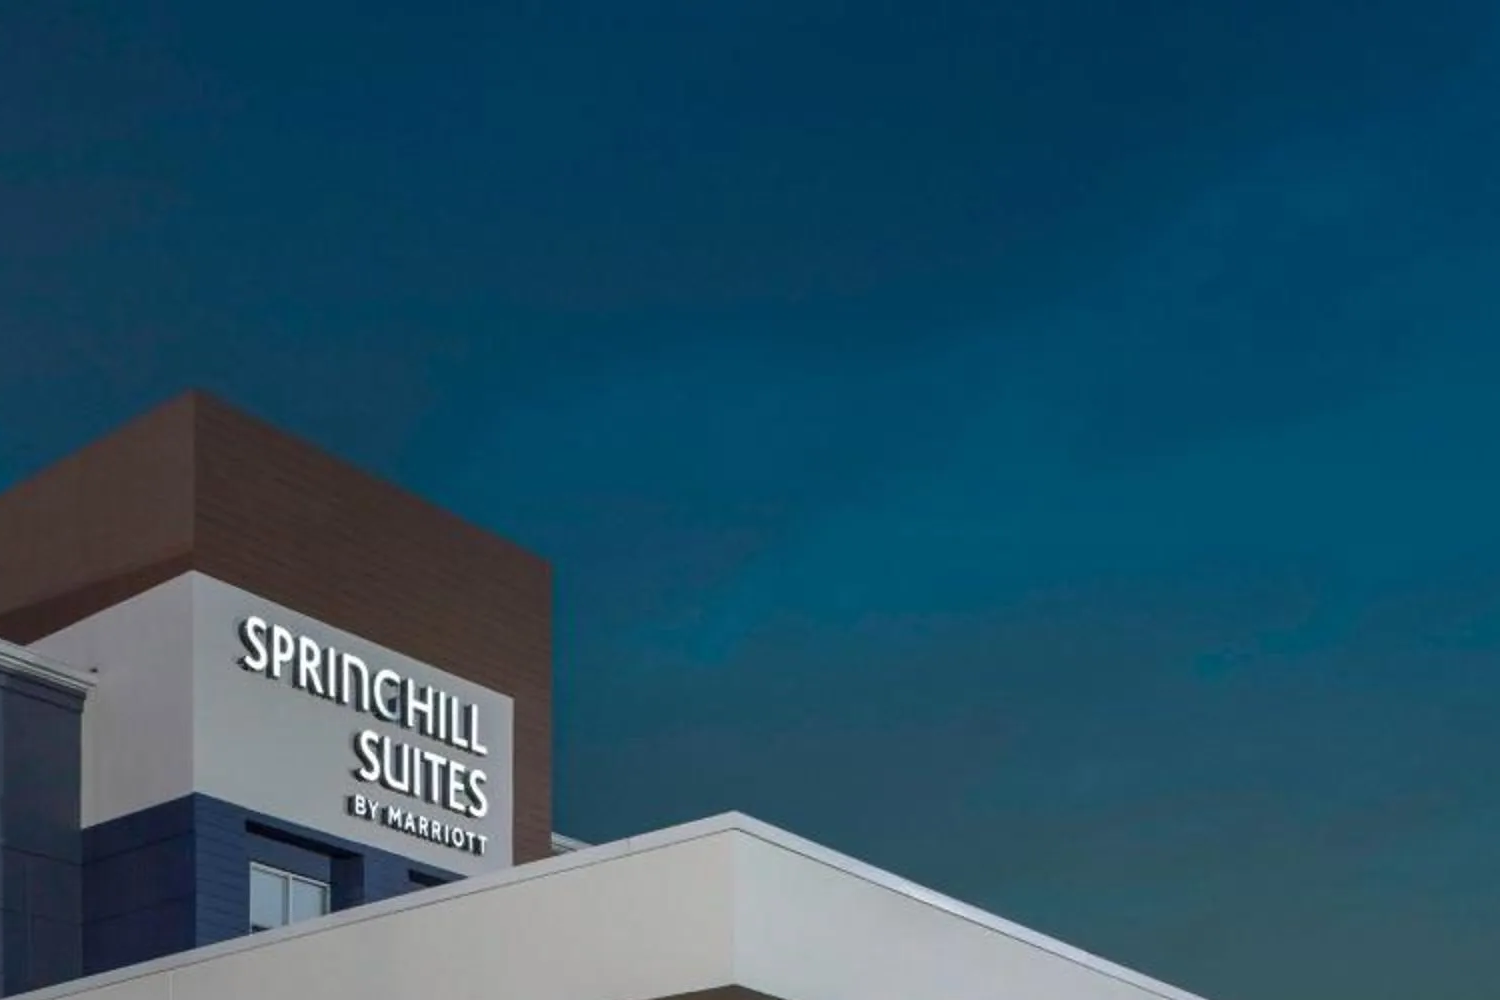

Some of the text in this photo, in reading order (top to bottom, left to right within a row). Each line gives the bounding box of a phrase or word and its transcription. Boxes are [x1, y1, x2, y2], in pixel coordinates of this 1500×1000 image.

[242, 616, 488, 755] SPRINGHILL
[356, 730, 488, 817] SUITES
[353, 794, 488, 854] BY MARRIOTT
